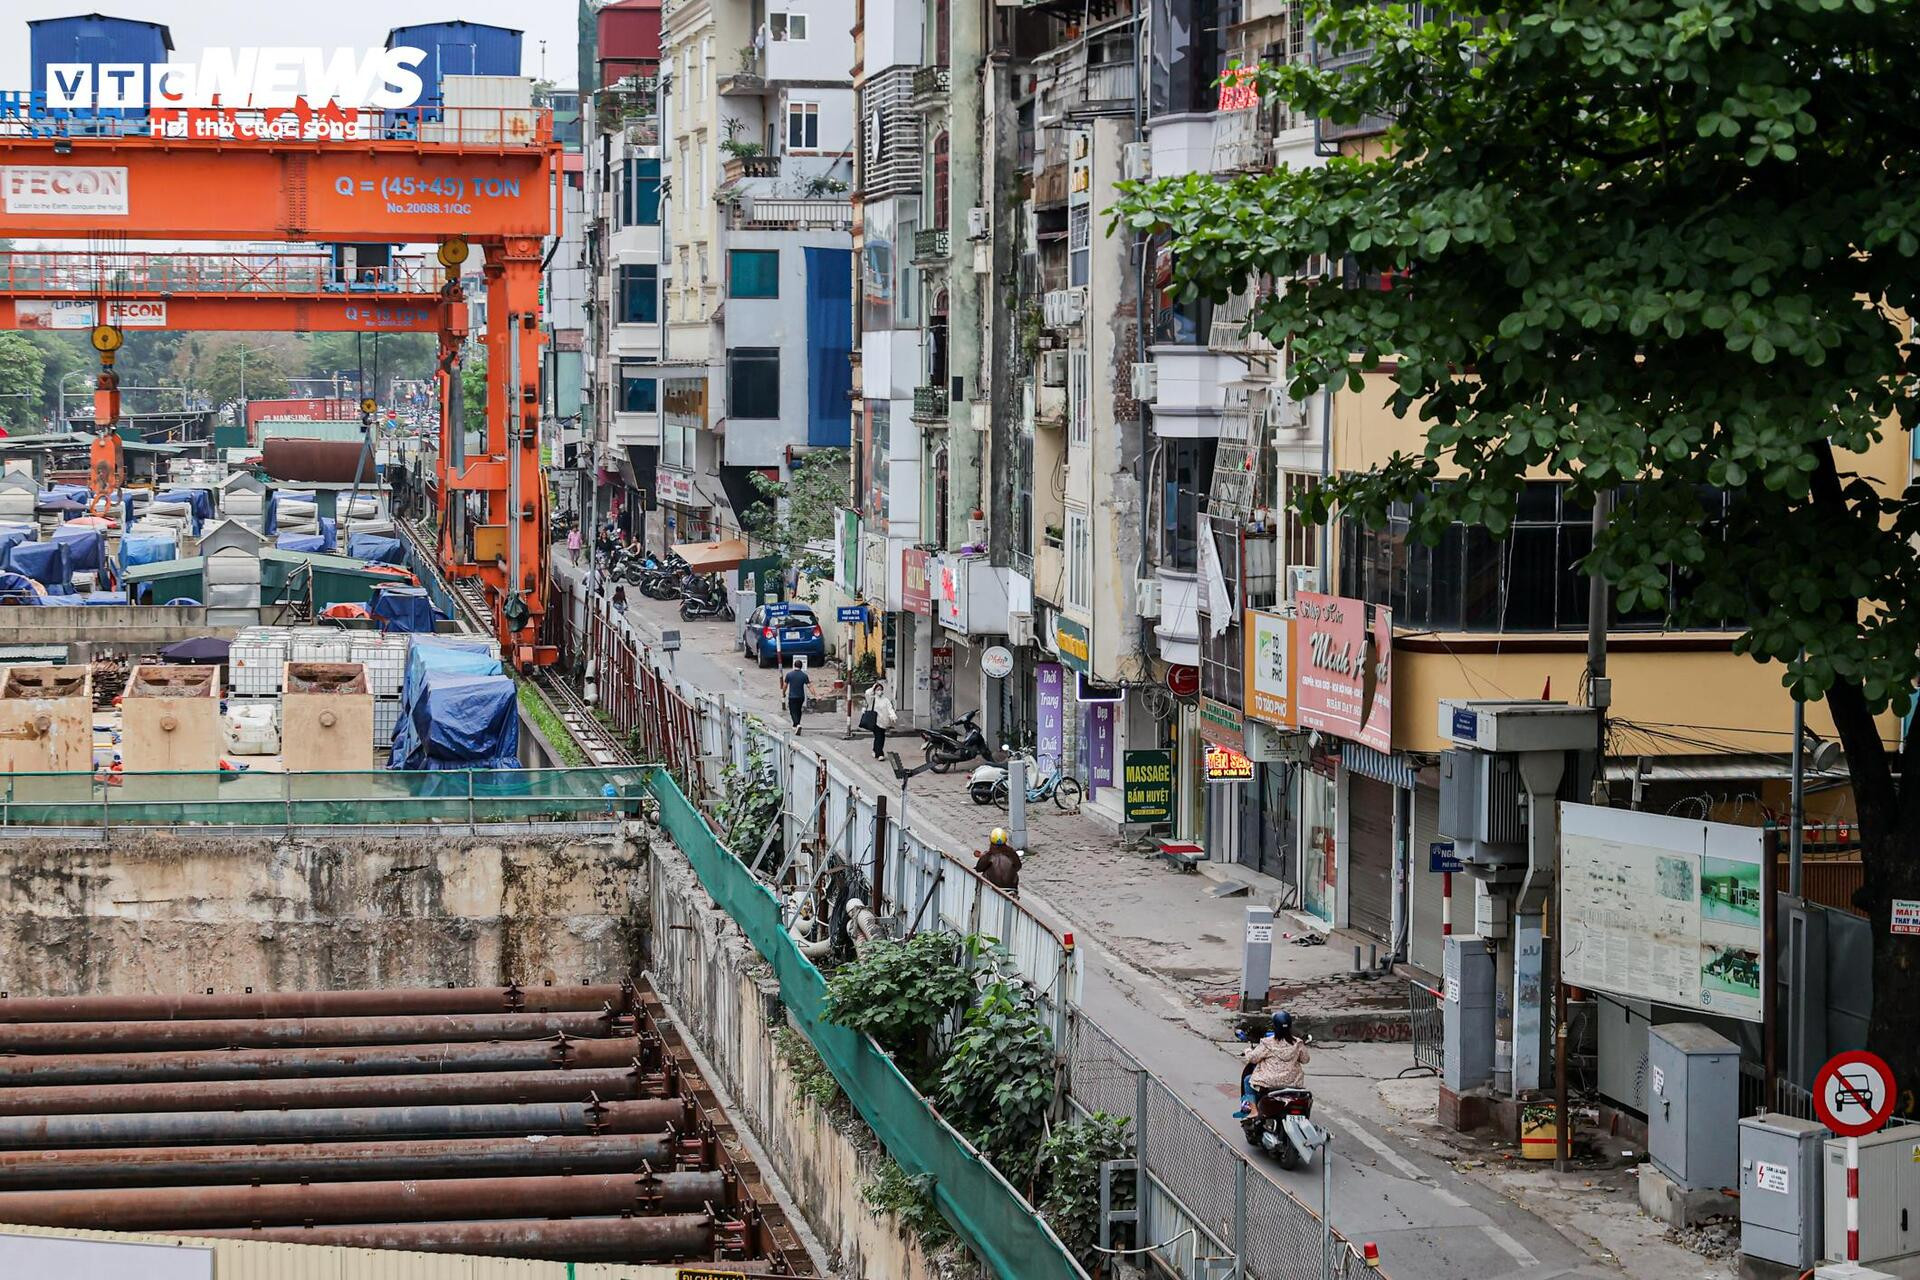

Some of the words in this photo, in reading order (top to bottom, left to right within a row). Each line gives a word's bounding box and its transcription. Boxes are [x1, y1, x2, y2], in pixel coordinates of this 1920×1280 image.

[11, 170, 121, 195] FECON
[335, 176, 354, 197] Q
[359, 180, 375, 192] =
[381, 176, 464, 200] (45+45)
[472, 177, 520, 197] TON
[110, 304, 163, 317] FECON
[346, 306, 358, 320] Q
[1310, 632, 1350, 676] Minh
[1043, 669, 1057, 684] Thời
[1040, 692, 1059, 709] Trang
[1045, 714, 1054, 728] Là
[1098, 725, 1106, 739] Là
[1041, 735, 1057, 751] Chất
[1208, 748, 1229, 769] YẾN
[1126, 765, 1170, 783] MASSAGE
[1128, 787, 1145, 803] BẤM
[1146, 787, 1169, 805] HUYỆT
